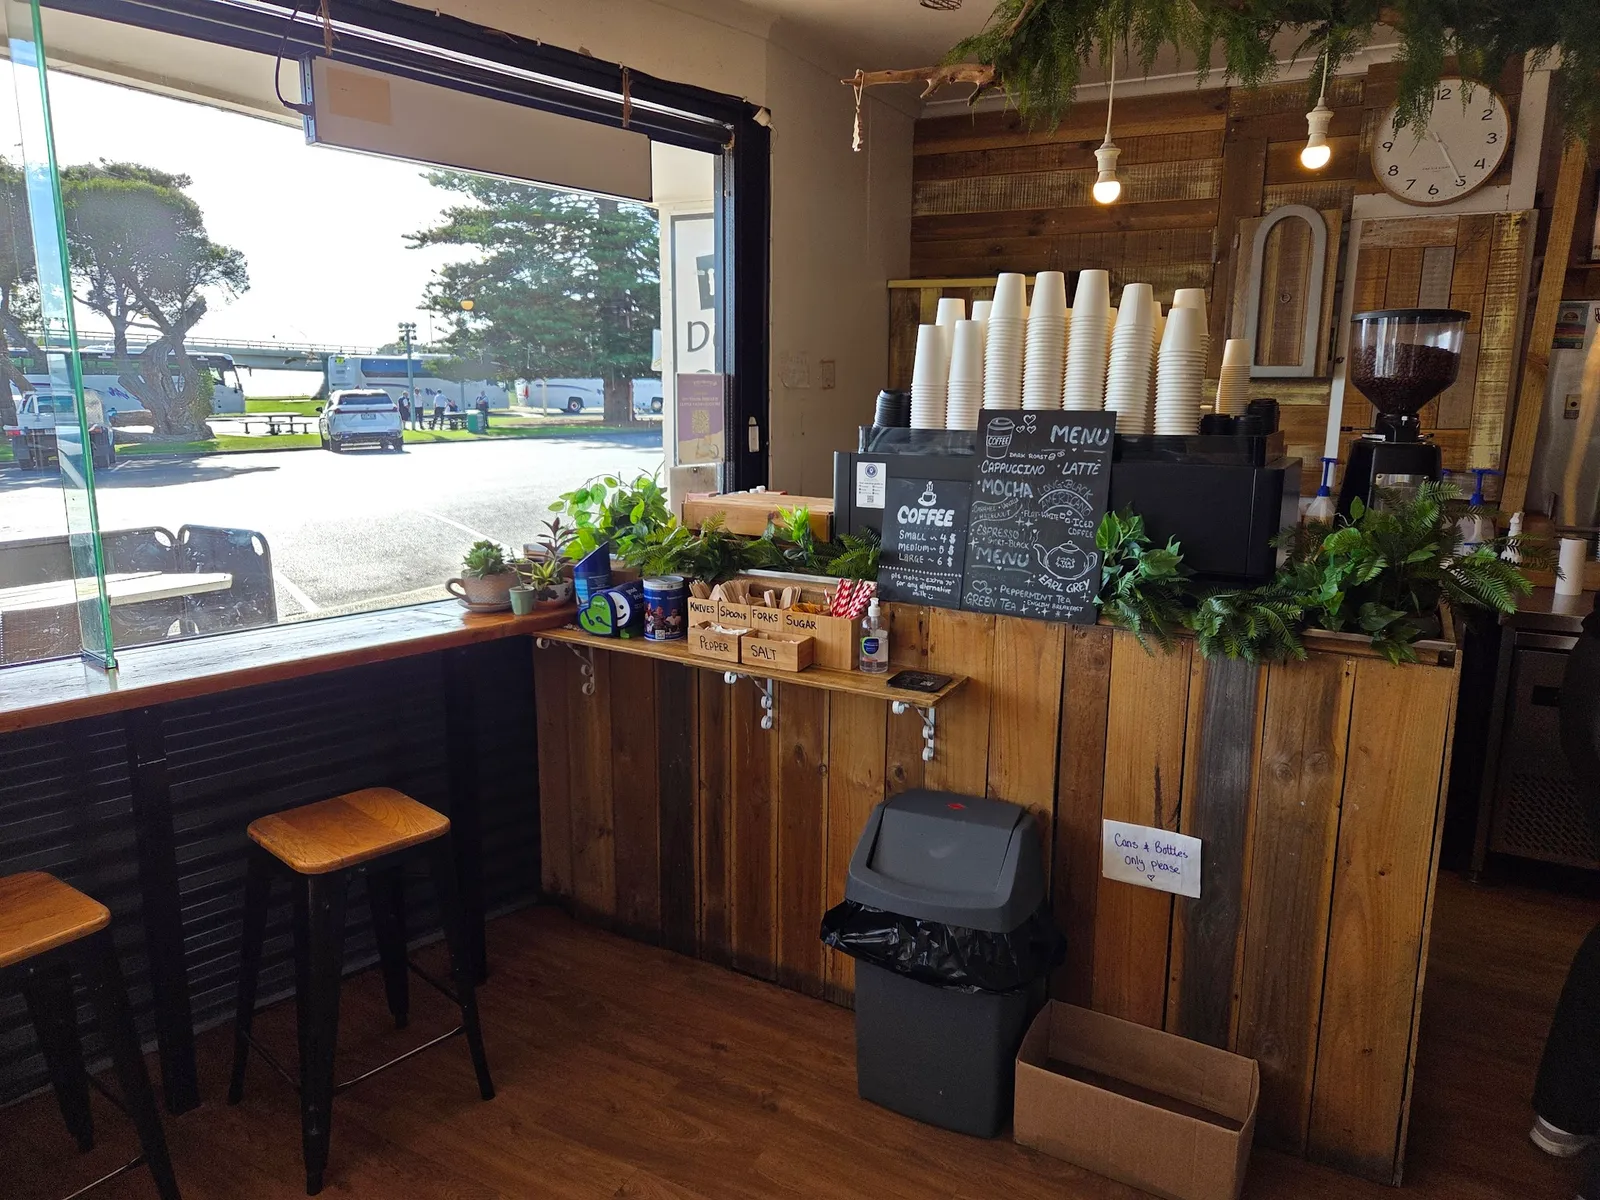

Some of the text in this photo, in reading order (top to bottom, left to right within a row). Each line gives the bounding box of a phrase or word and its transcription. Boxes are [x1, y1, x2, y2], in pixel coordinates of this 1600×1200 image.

[1436, 88, 1452, 101] 12
[1481, 108, 1494, 121] 2
[1486, 132, 1498, 145] 3
[1382, 141, 1394, 153] 9
[1387, 164, 1399, 176] 8
[1473, 157, 1486, 169] 4
[1405, 178, 1417, 191] 7
[1455, 175, 1467, 187] 5
[1427, 183, 1439, 195] 6
[687, 320, 715, 353] D
[1049, 424, 1110, 446] MENU
[980, 459, 1046, 475] CAPPUCCINO
[981, 478, 1034, 498] MOCHA
[1041, 491, 1092, 517] AMERICANO
[897, 505, 955, 527] COFFEE
[1073, 518, 1094, 528] ICED
[940, 533, 947, 543] 4
[949, 533, 957, 544] $
[976, 524, 1020, 539] ESPRESSO
[1068, 527, 1094, 539] COFFEE
[948, 544, 955, 556] $
[975, 546, 1030, 568] MENU
[937, 556, 943, 566] 6
[947, 556, 954, 568] $
[1039, 574, 1064, 592] EARL
[1066, 579, 1090, 593] GREY
[965, 592, 1017, 611] GREEN TEA
[1000, 584, 1072, 605] PEPPERMINT TEA
[689, 601, 715, 614] KNIVES
[720, 605, 747, 621] SPOONS
[752, 609, 779, 623] FORKS
[785, 614, 818, 630] SUGAR
[699, 635, 730, 653] PEPPER
[750, 644, 777, 661] SALT
[1114, 832, 1139, 849] Cans
[1154, 840, 1189, 859] Bottles
[1124, 855, 1181, 874] only please
